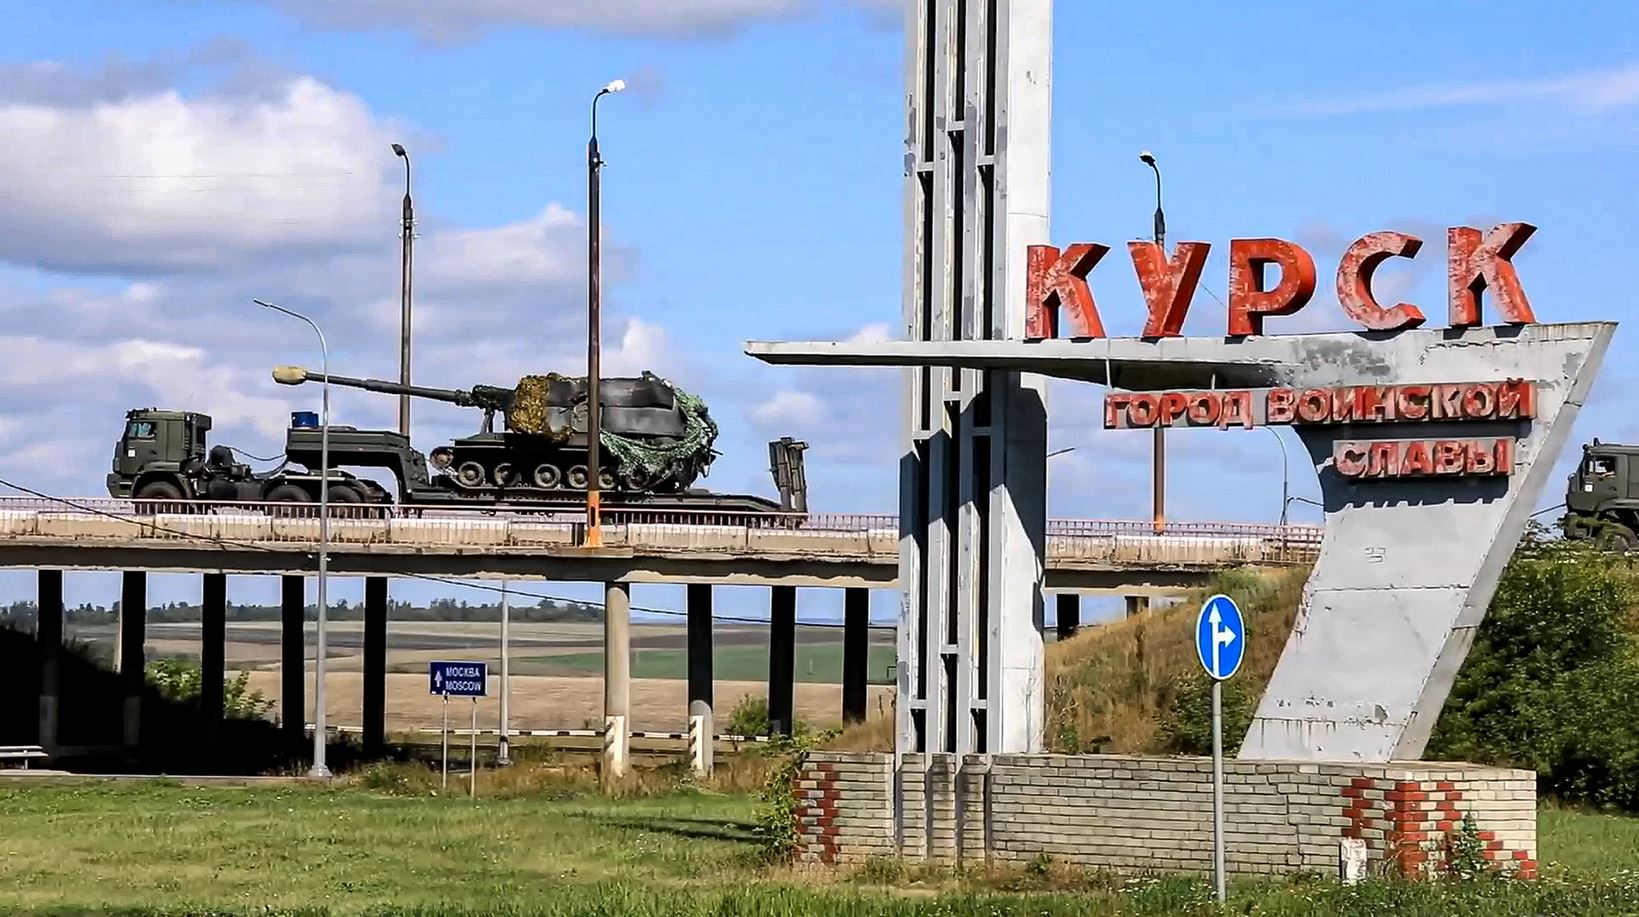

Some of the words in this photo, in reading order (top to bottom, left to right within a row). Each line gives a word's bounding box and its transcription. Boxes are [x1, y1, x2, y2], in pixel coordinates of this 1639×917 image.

[1026, 221, 1537, 339] КУРСК
[1104, 390, 1254, 430] ГОРОД
[1266, 378, 1534, 424] ВОИНСКОЙ
[1335, 438, 1512, 477] СЛАВЫ
[445, 680, 481, 691] MOSCOW
[446, 667, 480, 677] МОСКВА
